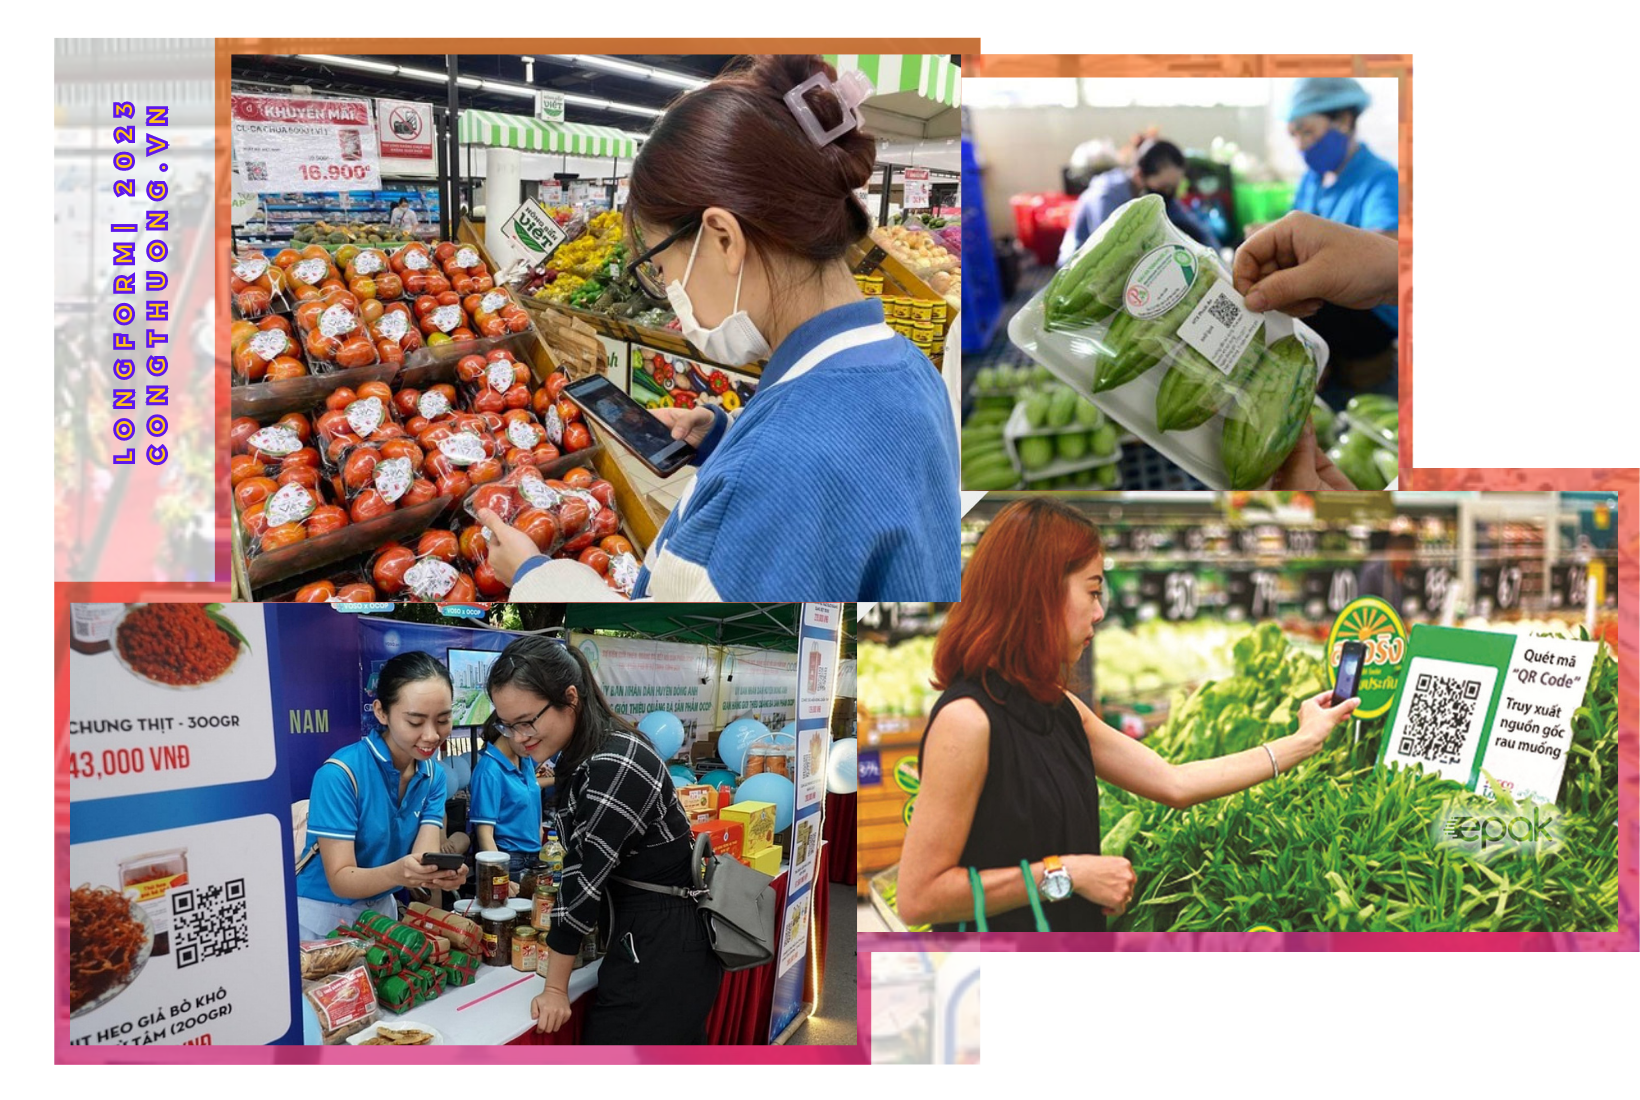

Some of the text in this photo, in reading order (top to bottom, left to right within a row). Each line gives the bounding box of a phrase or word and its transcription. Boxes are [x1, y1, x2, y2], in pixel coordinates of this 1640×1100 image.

[1523, 648, 1577, 668] Quét mã
[1506, 697, 1562, 718] Truy xuất
[137, 717, 174, 734] THỊT
[187, 715, 241, 729] 300GR
[289, 709, 330, 734] NAM
[1542, 724, 1566, 738] gốc
[149, 744, 191, 771] VNĐ
[1495, 737, 1562, 760] rau muống
[97, 1021, 134, 1043] HEO
[138, 1006, 166, 1028] GIẢ
[170, 998, 192, 1018] BÒ
[195, 986, 227, 1009] KHÔ
[170, 1003, 232, 1036] (200GR)
